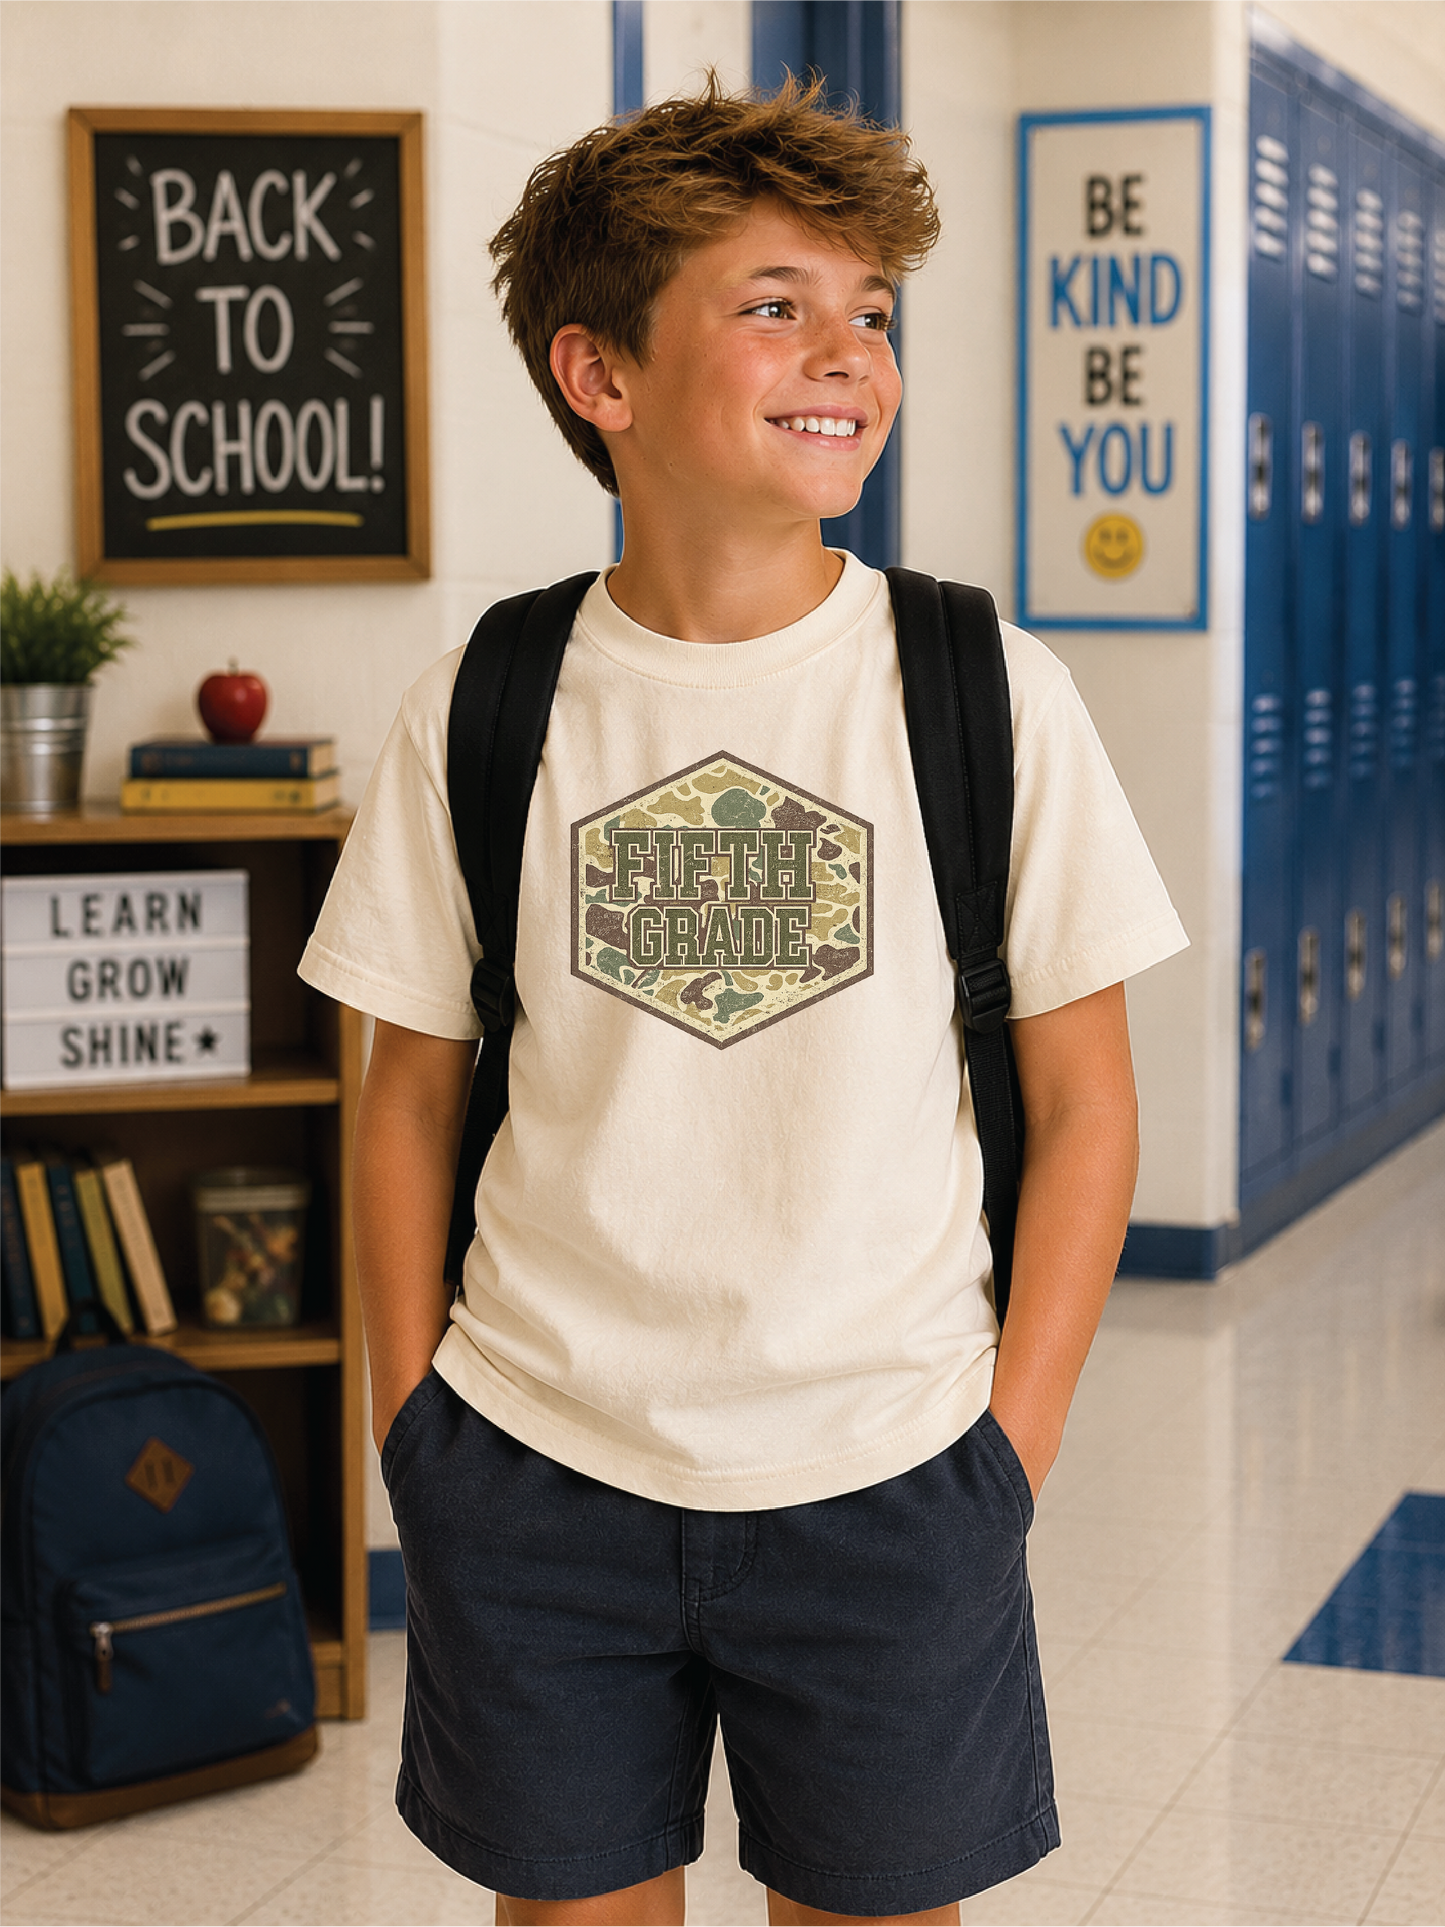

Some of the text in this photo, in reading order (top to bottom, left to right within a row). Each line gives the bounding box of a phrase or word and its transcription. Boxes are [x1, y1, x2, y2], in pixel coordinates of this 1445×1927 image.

[151, 169, 341, 265] BACK
[1085, 174, 1145, 238] BE
[1049, 252, 1183, 329] KIND
[197, 285, 295, 374] TO
[1084, 346, 1143, 406] BE
[123, 395, 386, 500] SCHOOL!
[1059, 422, 1174, 496] YOU
[610, 828, 817, 902] FIFTH
[50, 889, 203, 937] LEARN
[628, 904, 812, 969] GRADE
[67, 956, 190, 1001] GROW
[61, 1021, 184, 1068] SHINE
